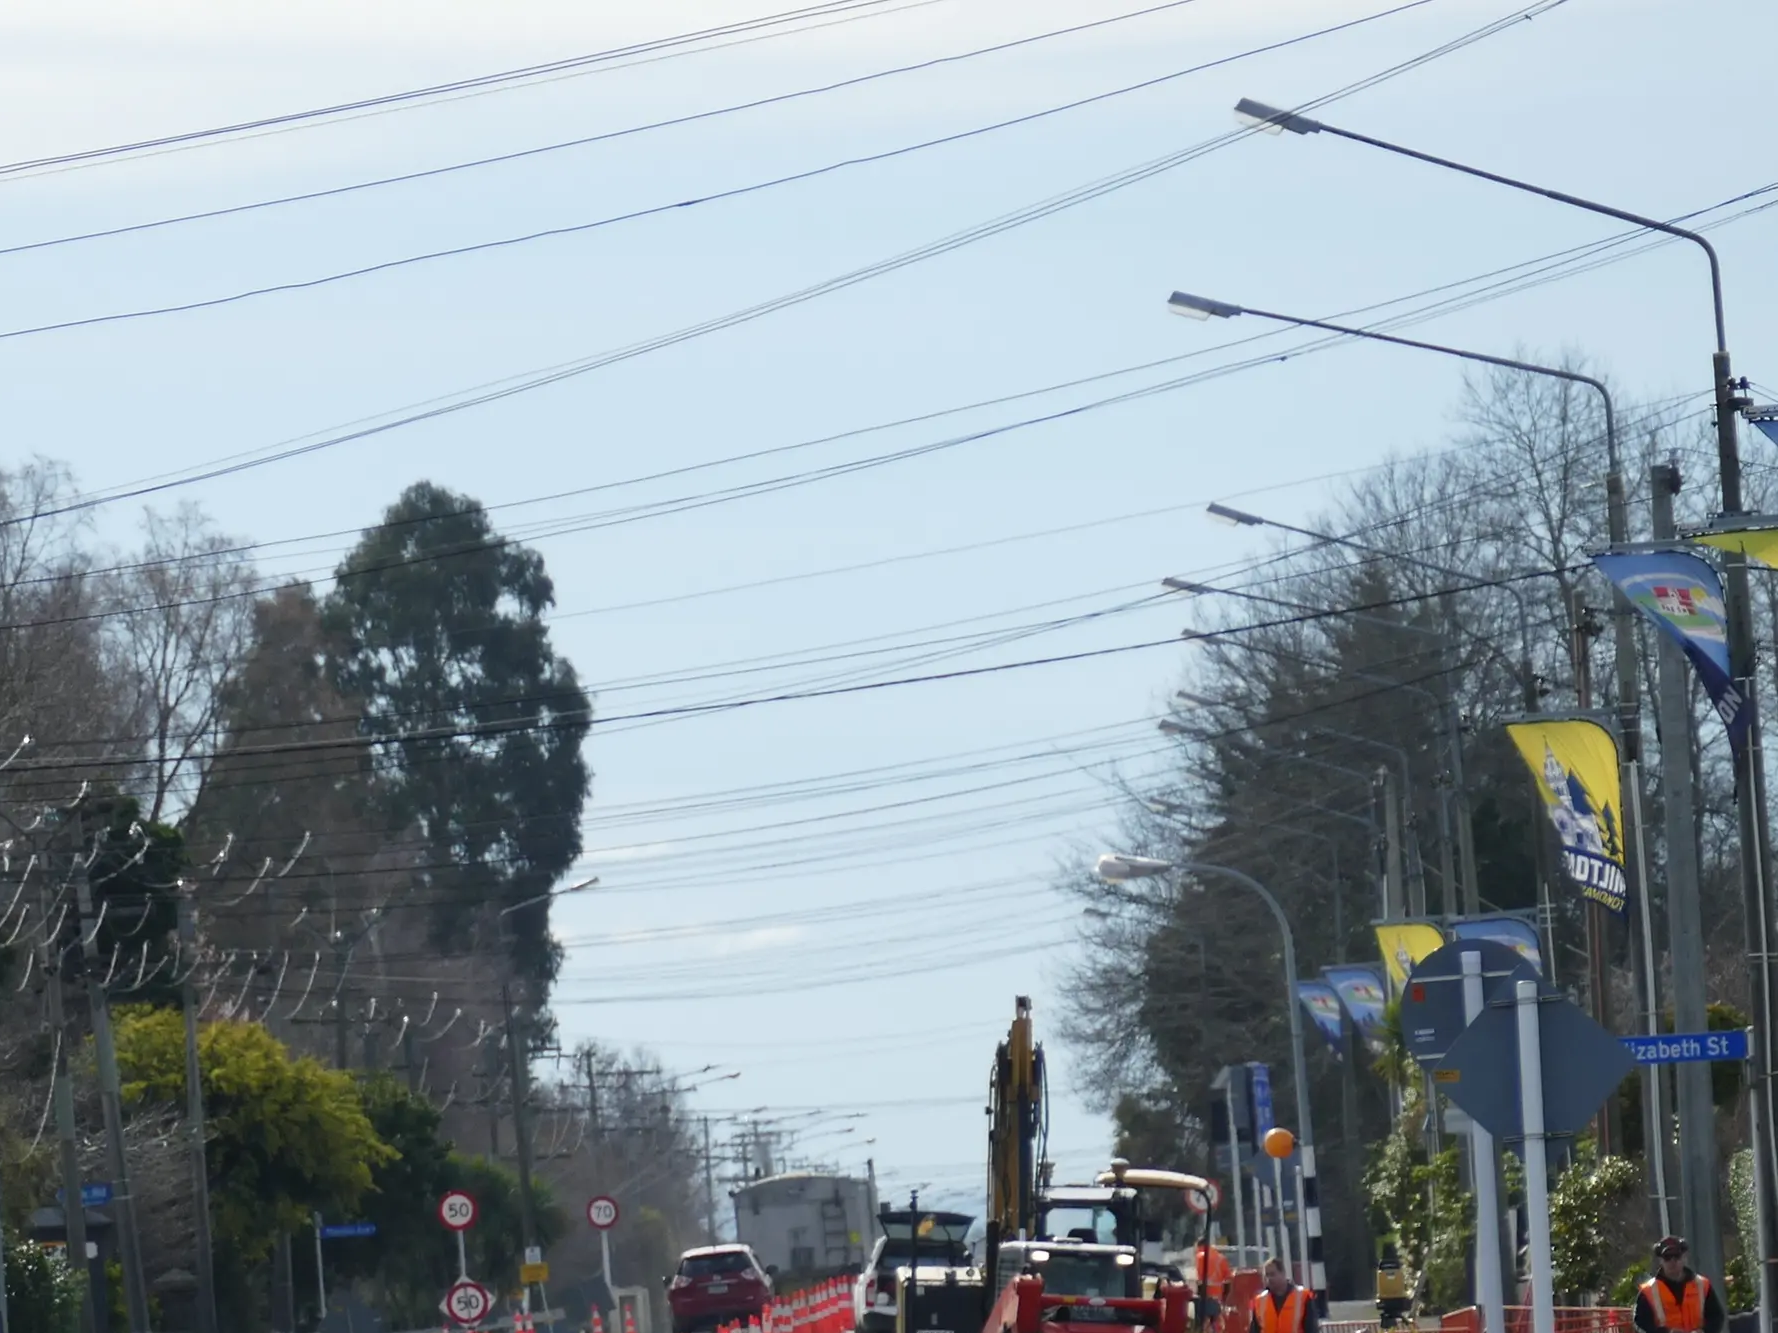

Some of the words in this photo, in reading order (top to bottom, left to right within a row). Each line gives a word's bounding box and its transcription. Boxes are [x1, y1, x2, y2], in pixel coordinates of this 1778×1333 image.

[1625, 1039, 1700, 1060] izabeth
[1707, 1036, 1729, 1055] St
[448, 1203, 470, 1218] 50
[594, 1204, 613, 1218] 70
[457, 1294, 479, 1312] 50
